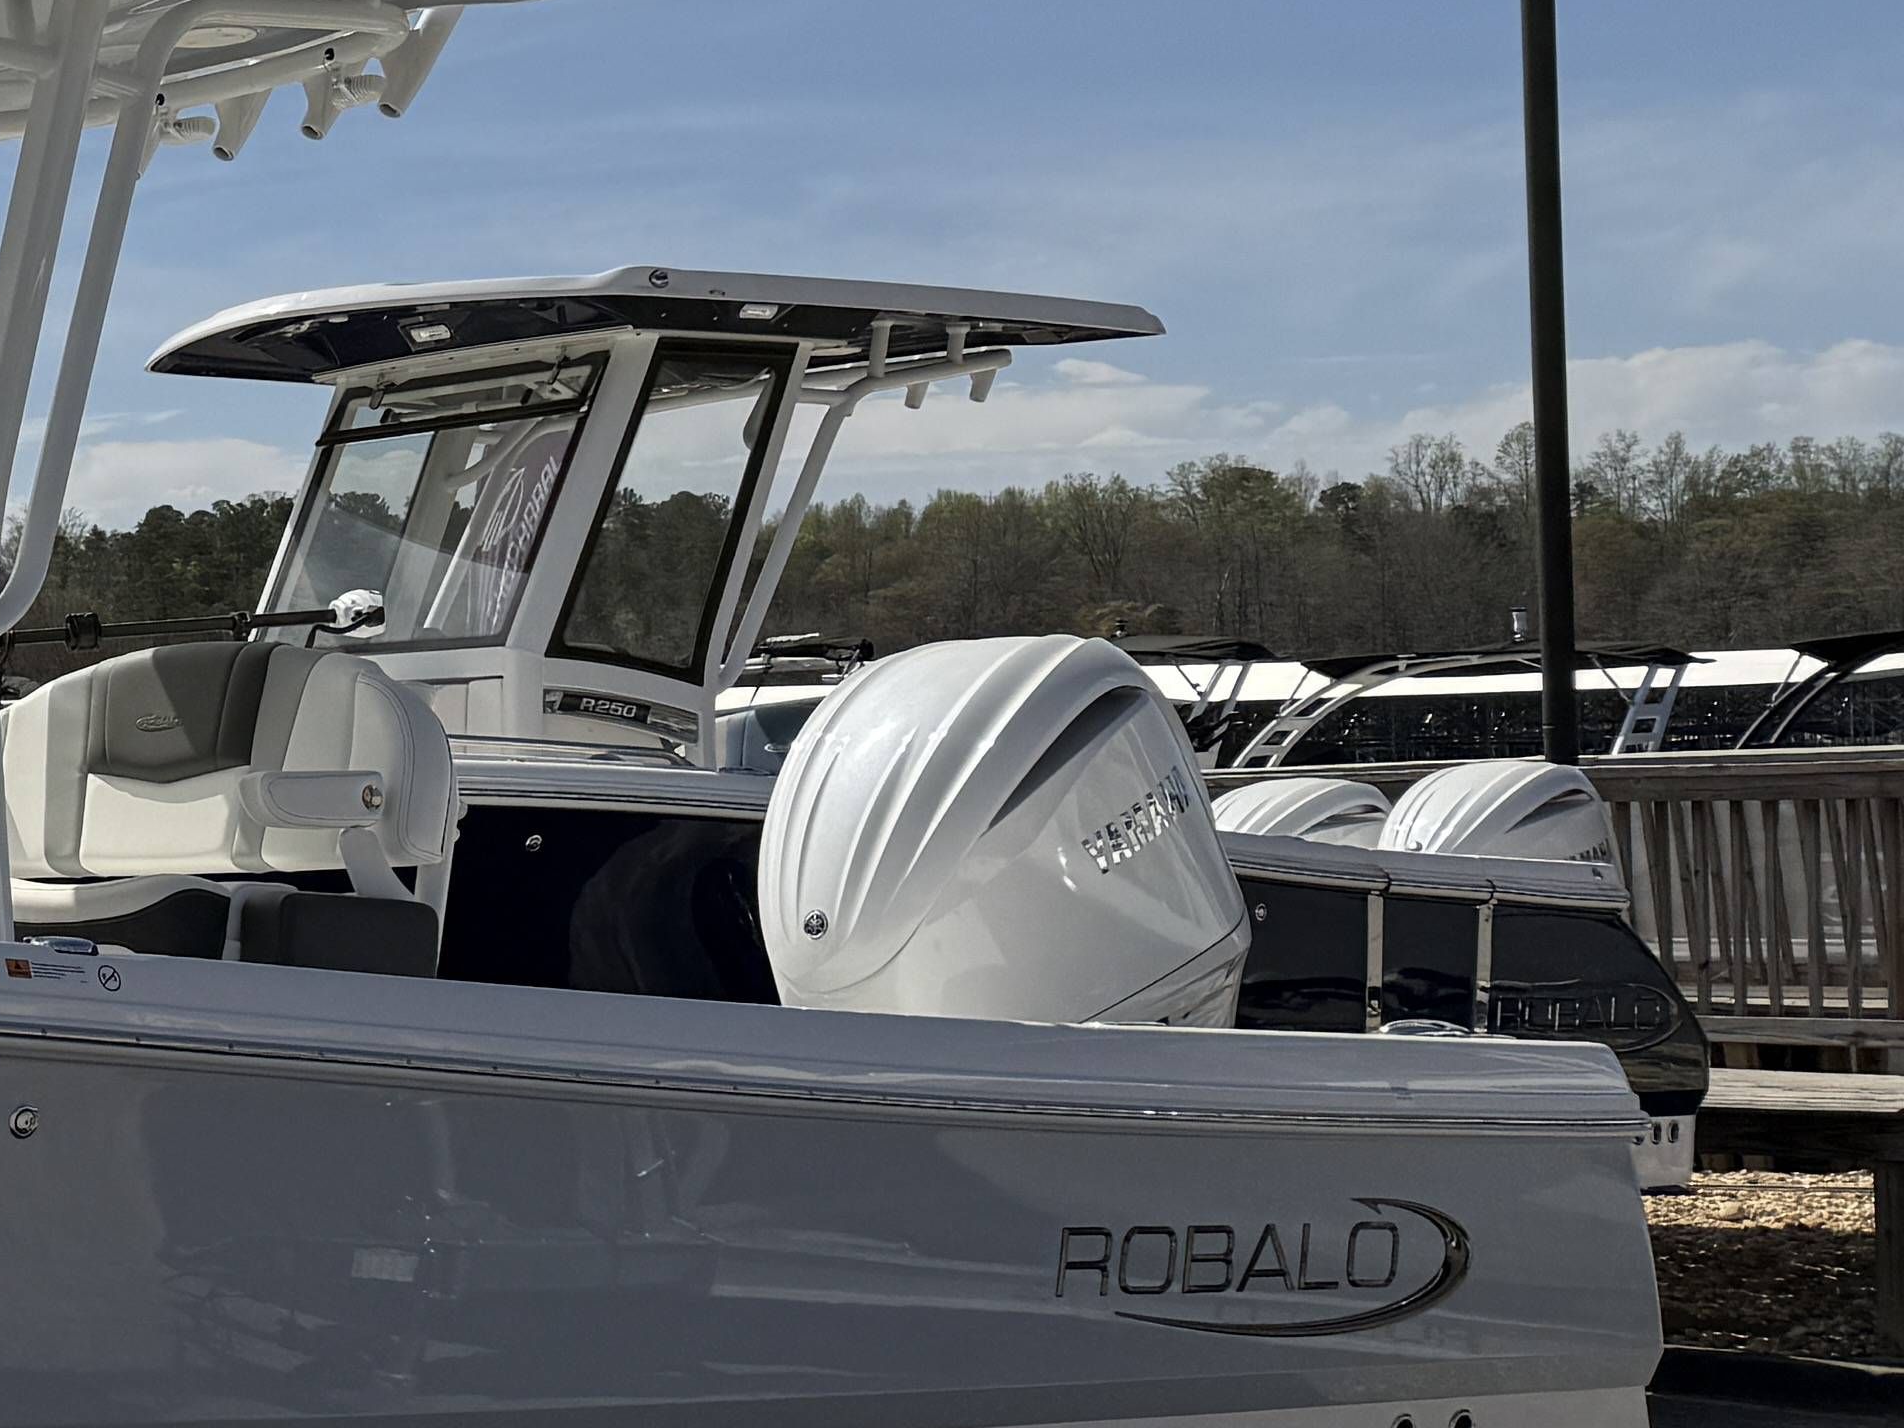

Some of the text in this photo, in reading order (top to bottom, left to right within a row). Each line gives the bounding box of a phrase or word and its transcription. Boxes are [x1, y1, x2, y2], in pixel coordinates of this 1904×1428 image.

[580, 698, 637, 718] R250
[1081, 766, 1190, 874] YAMAHA
[1056, 1220, 1400, 1298] ROBALO
